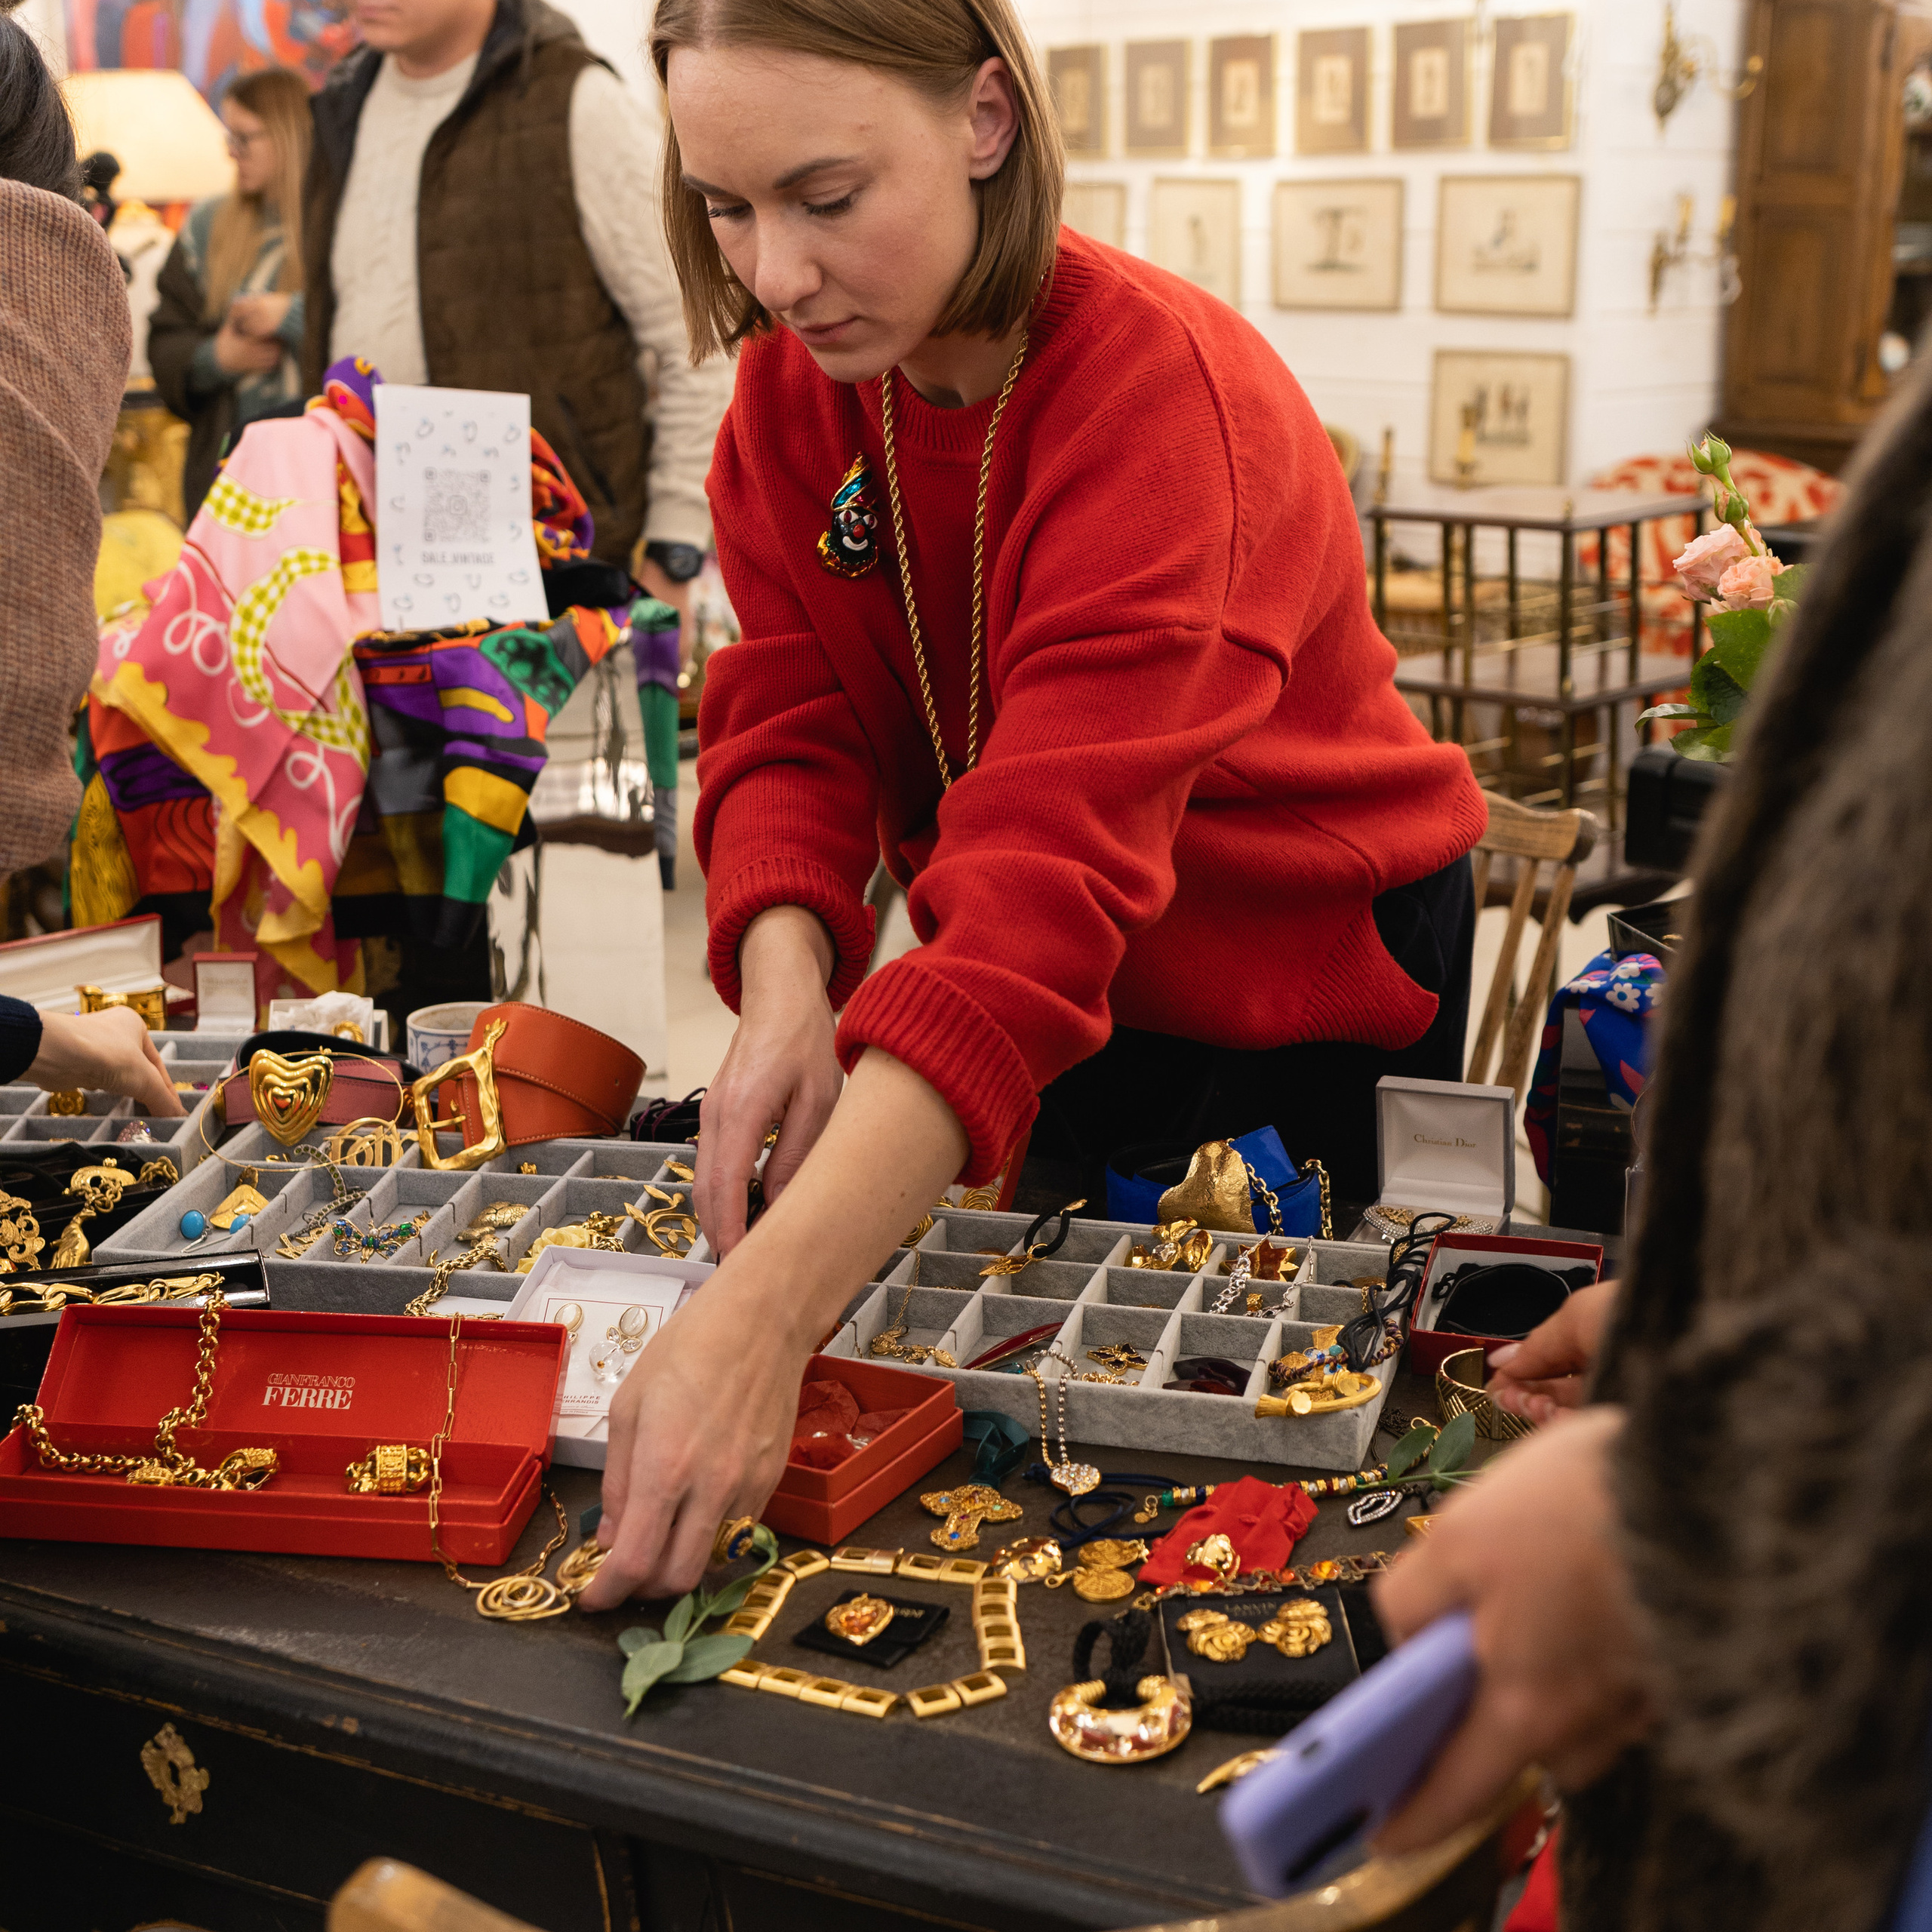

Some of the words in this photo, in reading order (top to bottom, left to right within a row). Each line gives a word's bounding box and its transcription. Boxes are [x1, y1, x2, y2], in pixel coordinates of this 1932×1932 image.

[1414, 1134, 1452, 1146] Christian
[1455, 1137, 1477, 1148] Dior
[267, 1373, 356, 1389] GIANFRANCO
[261, 1386, 353, 1410] FERRE
